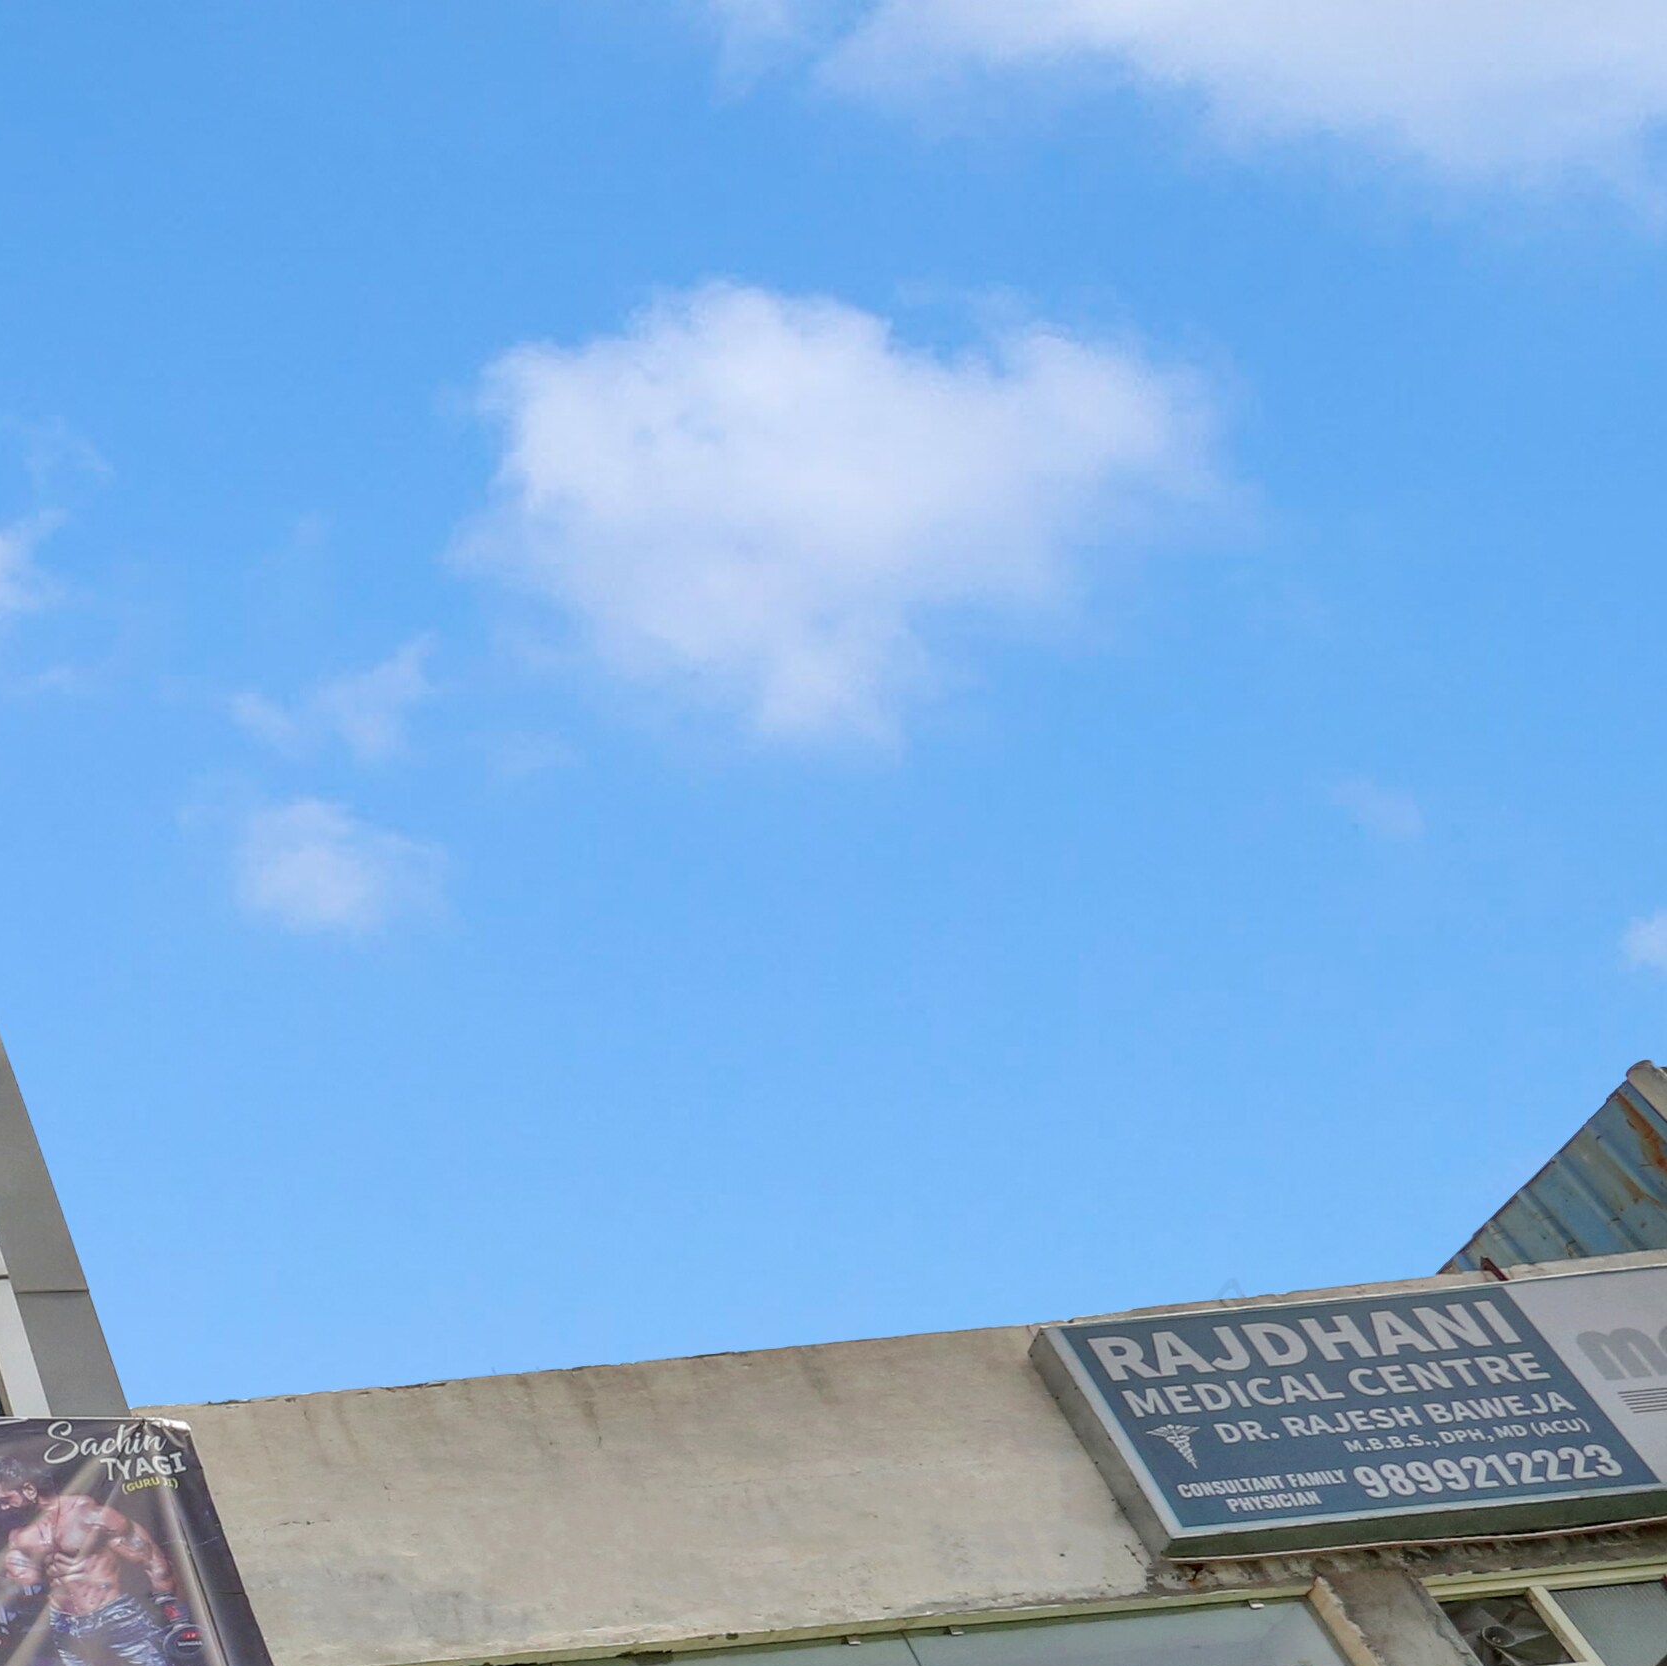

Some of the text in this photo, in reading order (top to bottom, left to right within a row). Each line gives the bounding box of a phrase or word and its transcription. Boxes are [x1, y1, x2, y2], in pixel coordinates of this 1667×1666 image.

[1087, 1299, 1523, 1383] RAJDHANI
[1120, 1372, 1347, 1420] MEDICAL
[1347, 1351, 1553, 1399] CENTRE
[1212, 1390, 1578, 1446] DR. RAJESH BAWEJA
[1494, 1420, 1529, 1442] MD
[1530, 1415, 1593, 1440] (ACU)
[43, 1420, 188, 1483] Sachin TYAGI
[1175, 1443, 1624, 1500] CONSULTANT FAMILY 9899212223
[1225, 1489, 1323, 1514] PHYSICIAN
